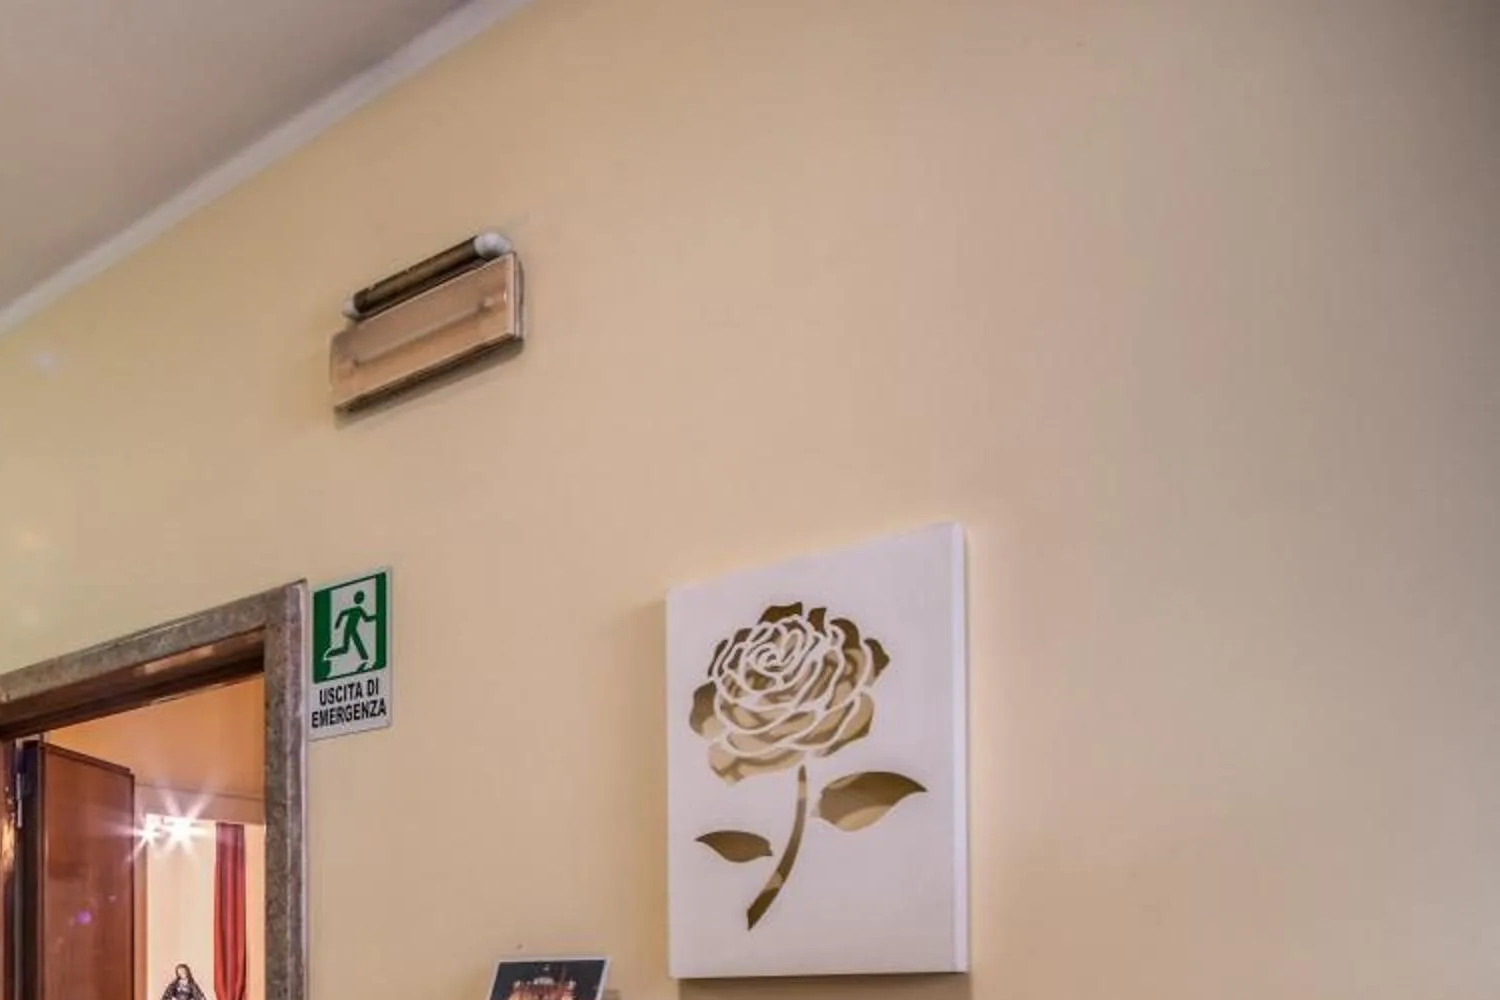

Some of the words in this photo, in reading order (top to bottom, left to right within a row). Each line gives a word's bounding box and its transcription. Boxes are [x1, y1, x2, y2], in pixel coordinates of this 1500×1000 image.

[319, 681, 363, 706] USCITA
[367, 677, 379, 696] DI
[311, 698, 387, 728] EMERGENZA
